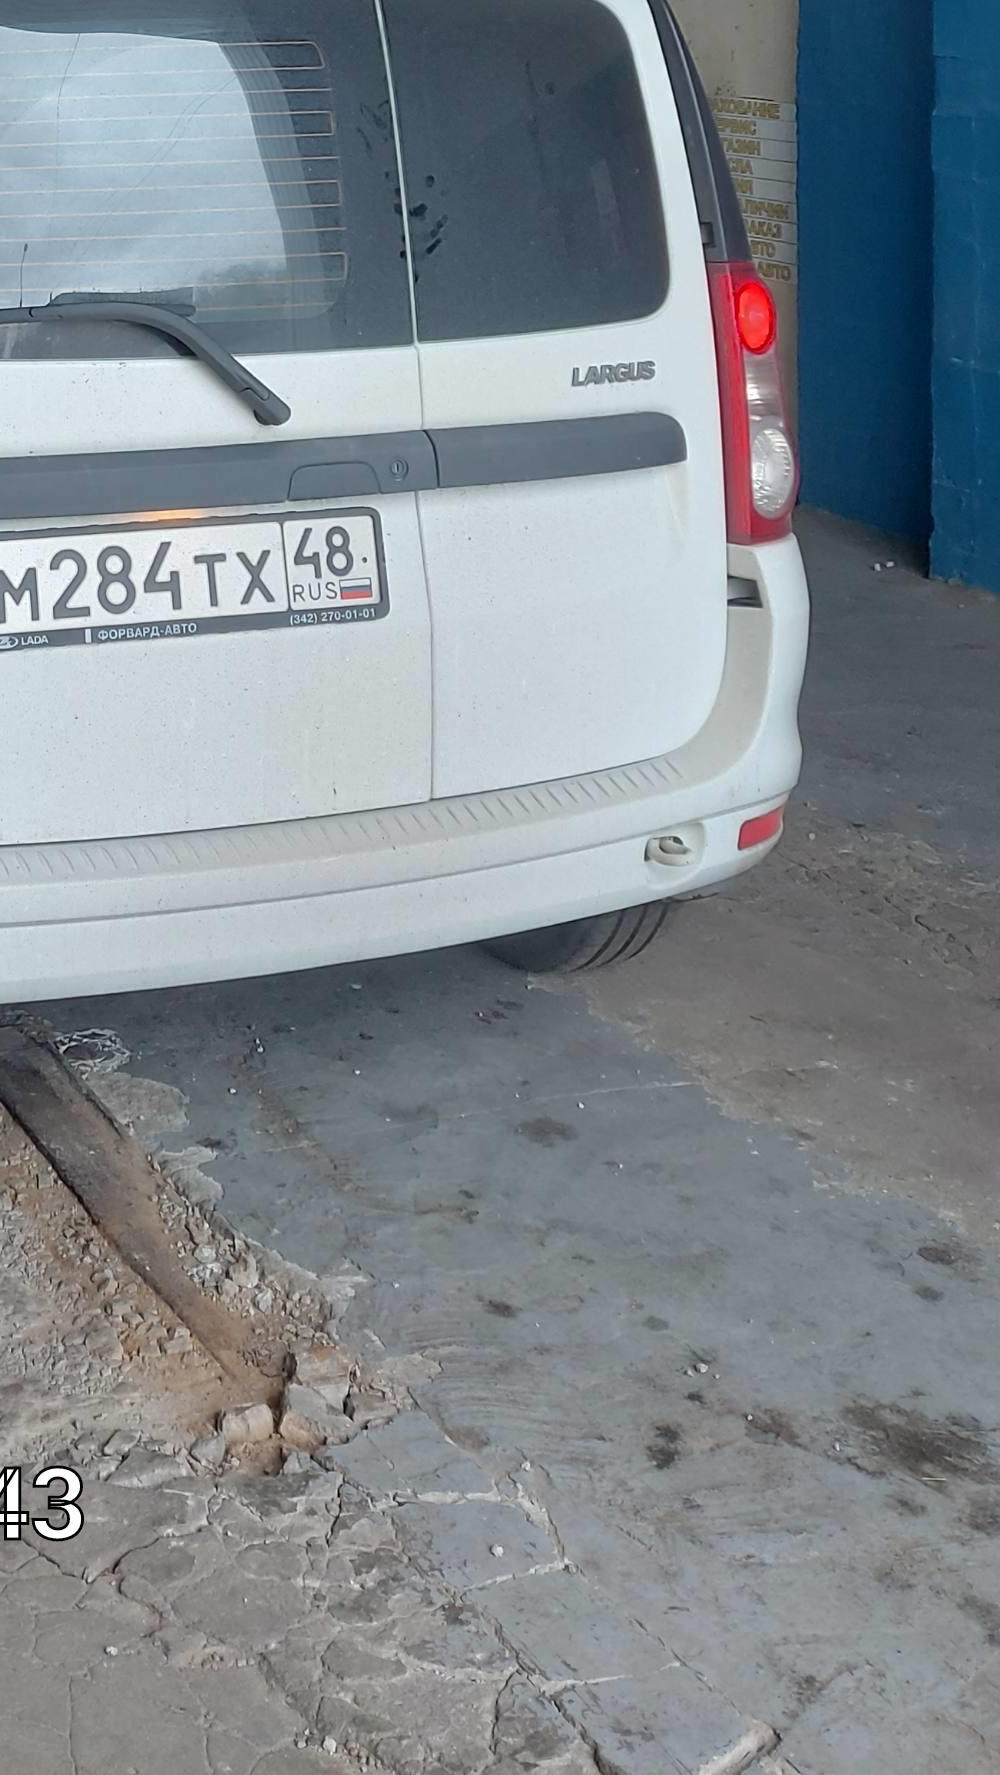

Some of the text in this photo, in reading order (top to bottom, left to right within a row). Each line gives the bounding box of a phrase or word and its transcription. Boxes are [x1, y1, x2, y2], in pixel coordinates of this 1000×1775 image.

[570, 360, 656, 387] LARGUS
[293, 525, 355, 580] 48
[292, 581, 338, 603] RUS
[289, 608, 376, 626] (342) 270-01-01
[21, 635, 49, 646] LADA
[97, 622, 197, 641] ФОРВАРД-АВТО
